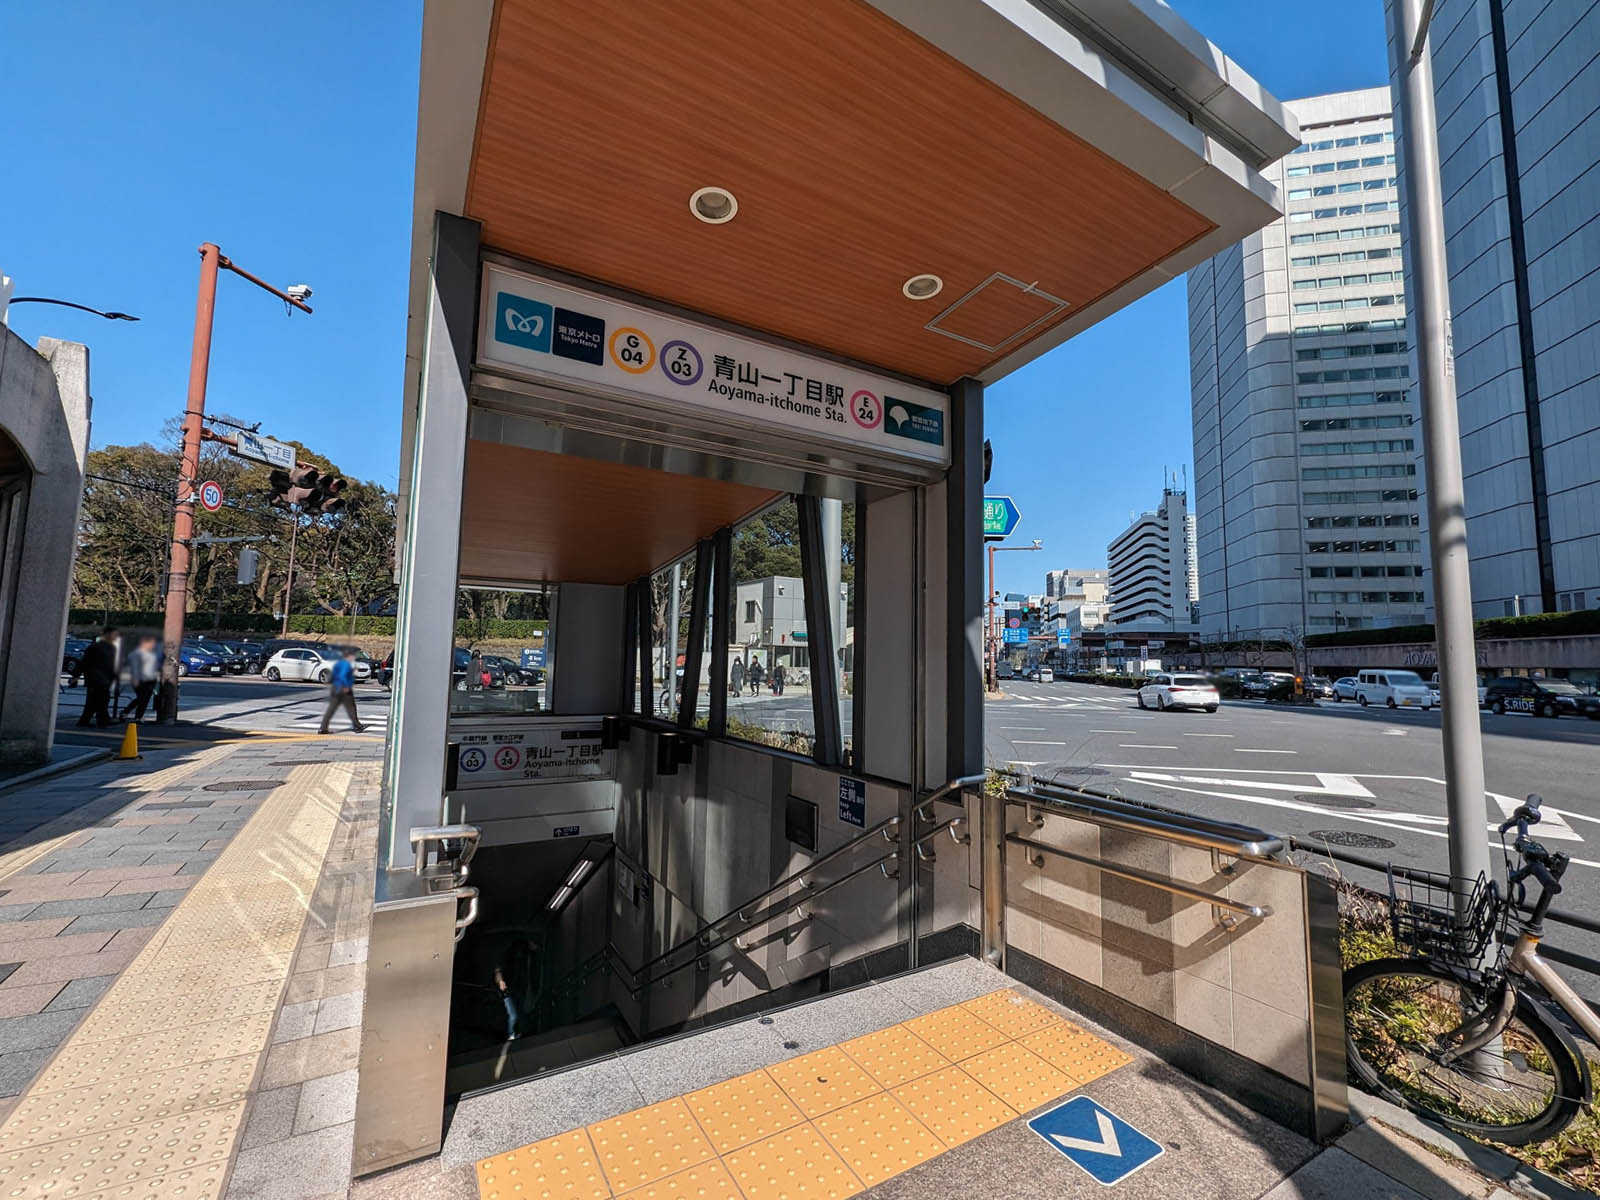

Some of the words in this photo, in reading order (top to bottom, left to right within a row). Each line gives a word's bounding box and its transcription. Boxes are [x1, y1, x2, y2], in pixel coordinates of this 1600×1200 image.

[558, 325, 600, 343] 東京メトロ
[560, 333, 579, 344] Tokyo
[579, 339, 598, 349] Metro
[626, 335, 639, 348] G
[620, 348, 644, 365] 04
[676, 348, 688, 361] Z
[671, 362, 692, 377] 03
[713, 354, 844, 408] 青山一丁目駅
[708, 379, 821, 417] Aoyama-itchome
[825, 406, 848, 424] Sta.
[863, 397, 869, 408] E
[858, 407, 874, 421] 24
[205, 489, 218, 504] 50
[1504, 700, 1535, 711] S.RIDE
[525, 745, 604, 760] 青山一丁目駅
[466, 760, 480, 768] 03
[501, 758, 513, 766] 24
[524, 758, 600, 769] Aoyama-itchome
[524, 770, 542, 778] Sta.
[840, 809, 852, 821] Left
